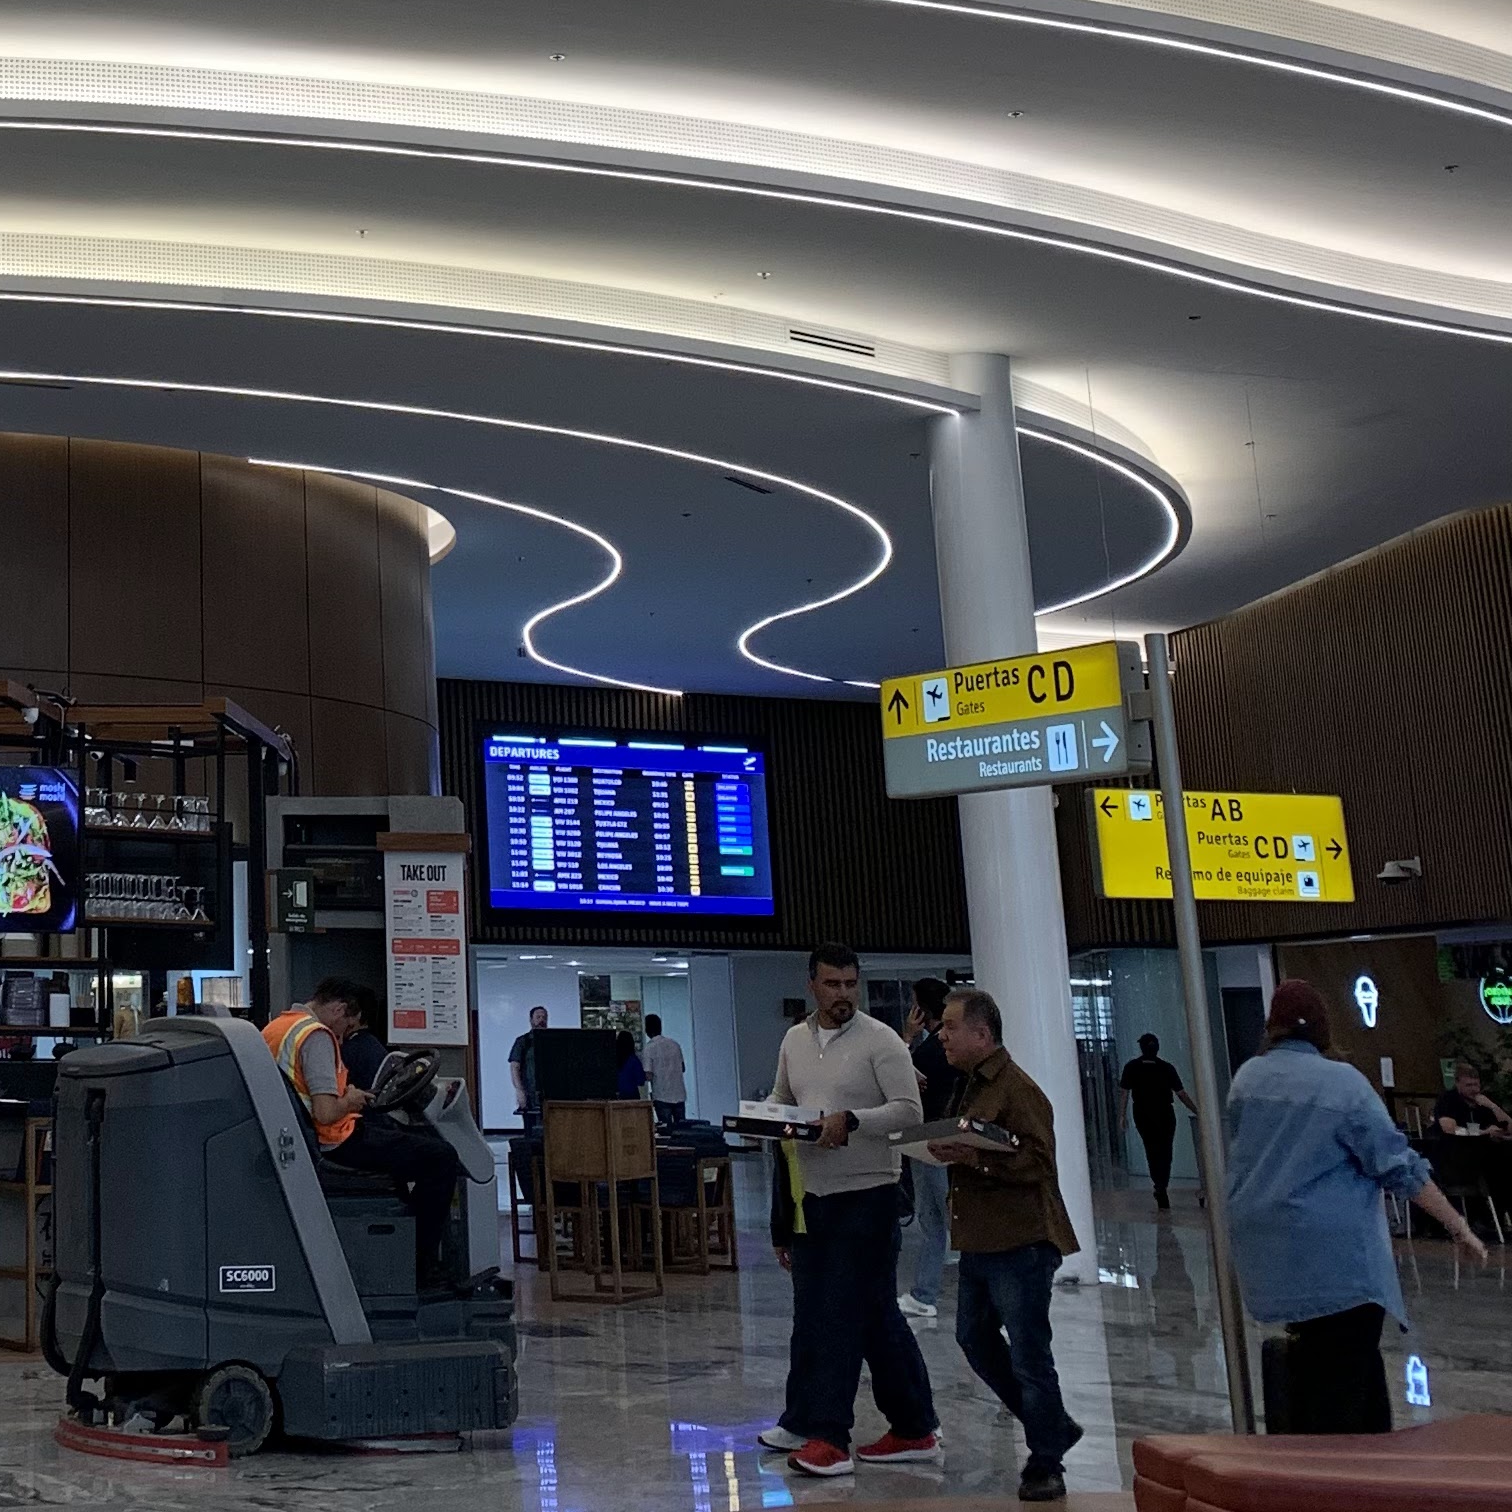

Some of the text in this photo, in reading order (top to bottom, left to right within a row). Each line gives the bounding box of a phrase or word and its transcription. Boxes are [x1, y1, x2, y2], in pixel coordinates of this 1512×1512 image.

[954, 665, 1019, 694] Puertas
[956, 701, 985, 716] Gates
[489, 746, 560, 760] DEPARTURES
[927, 728, 1040, 763] Restaurantes
[979, 756, 1042, 778] Restaurants
[39, 782, 66, 792] moshi
[39, 791, 66, 802] moshi
[1155, 794, 1207, 809] Ptas
[1197, 831, 1249, 847] Puertas
[1228, 849, 1251, 859] Gates
[400, 864, 447, 882] TAKE OUT
[1155, 866, 1293, 886] Remo de equipaje
[1237, 886, 1271, 897] Baggage
[226, 1269, 269, 1282] SC6000
